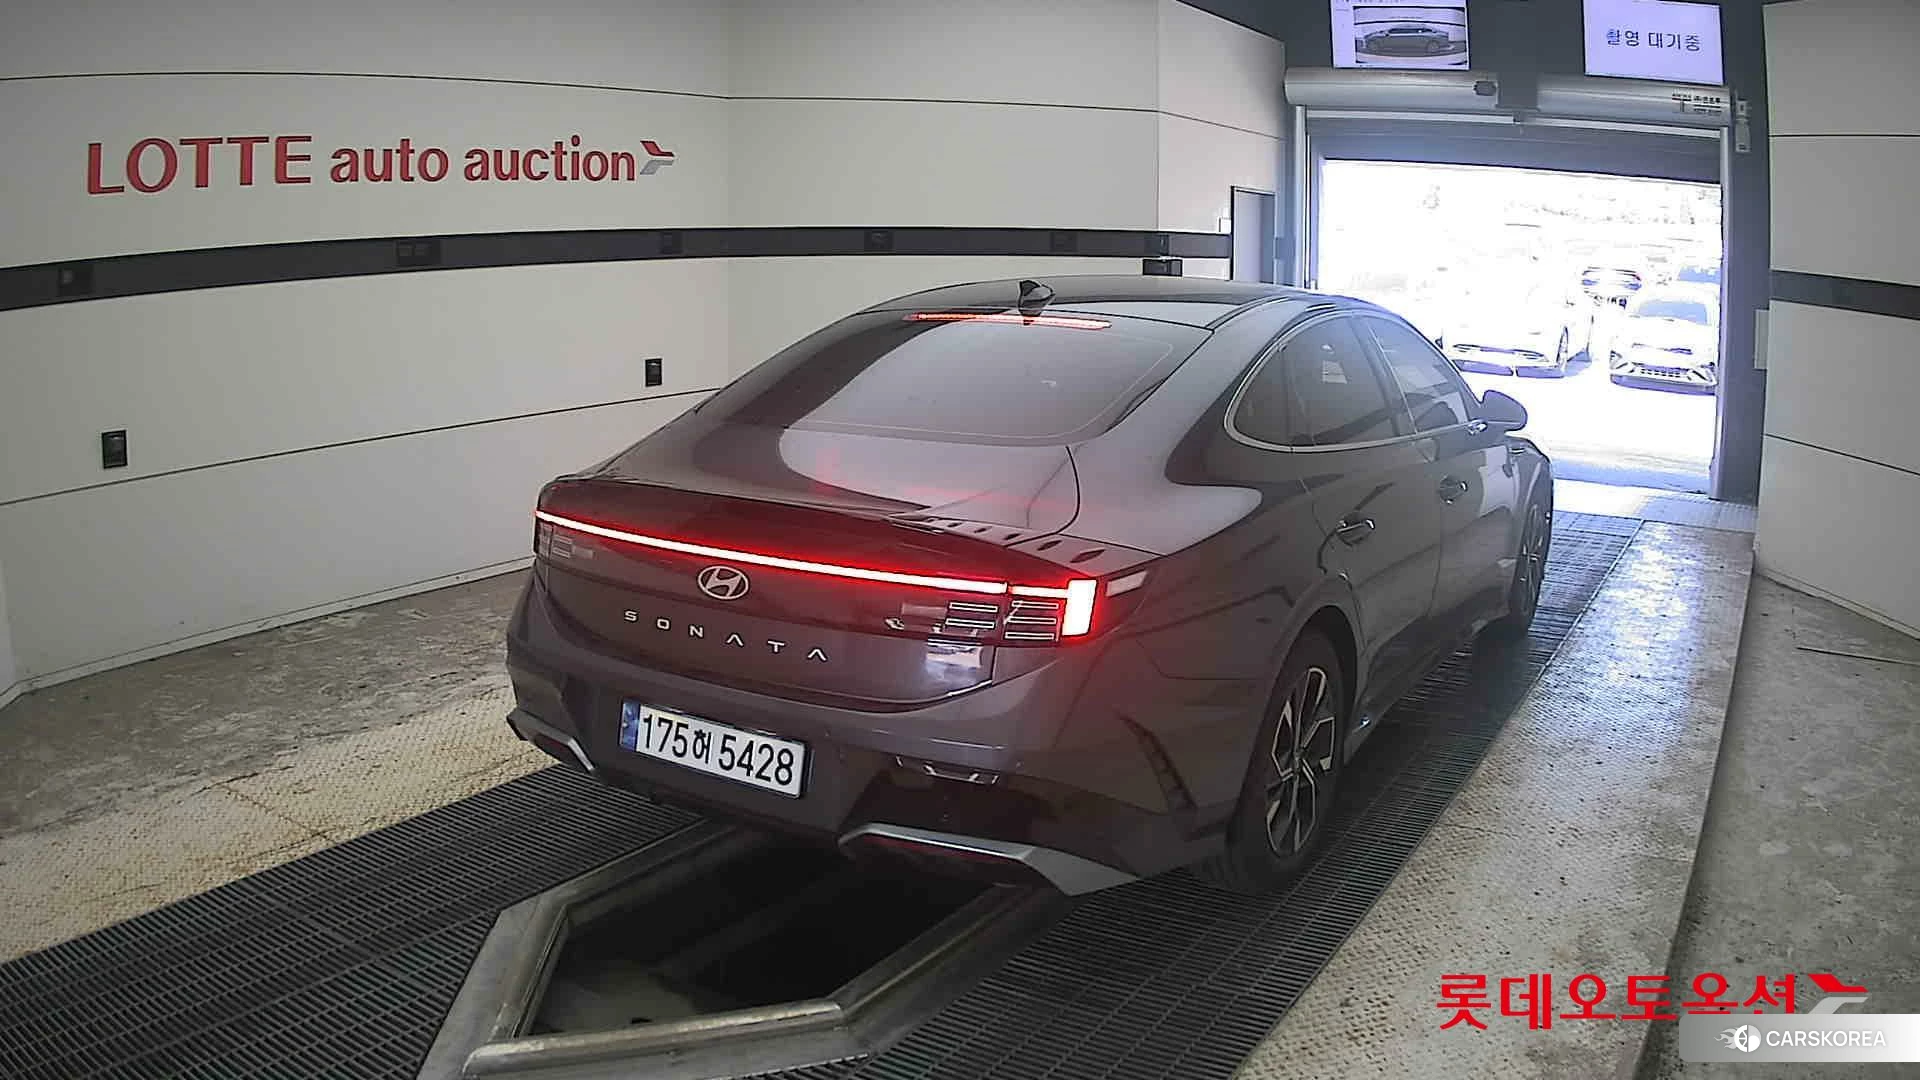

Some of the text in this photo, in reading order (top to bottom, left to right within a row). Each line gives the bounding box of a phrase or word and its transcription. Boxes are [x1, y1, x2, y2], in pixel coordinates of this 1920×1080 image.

[1648, 32, 1701, 52] 대기중
[86, 135, 636, 195] LOTTE auto auction
[624, 609, 828, 662] SONATA
[642, 713, 795, 786] 175허 5428
